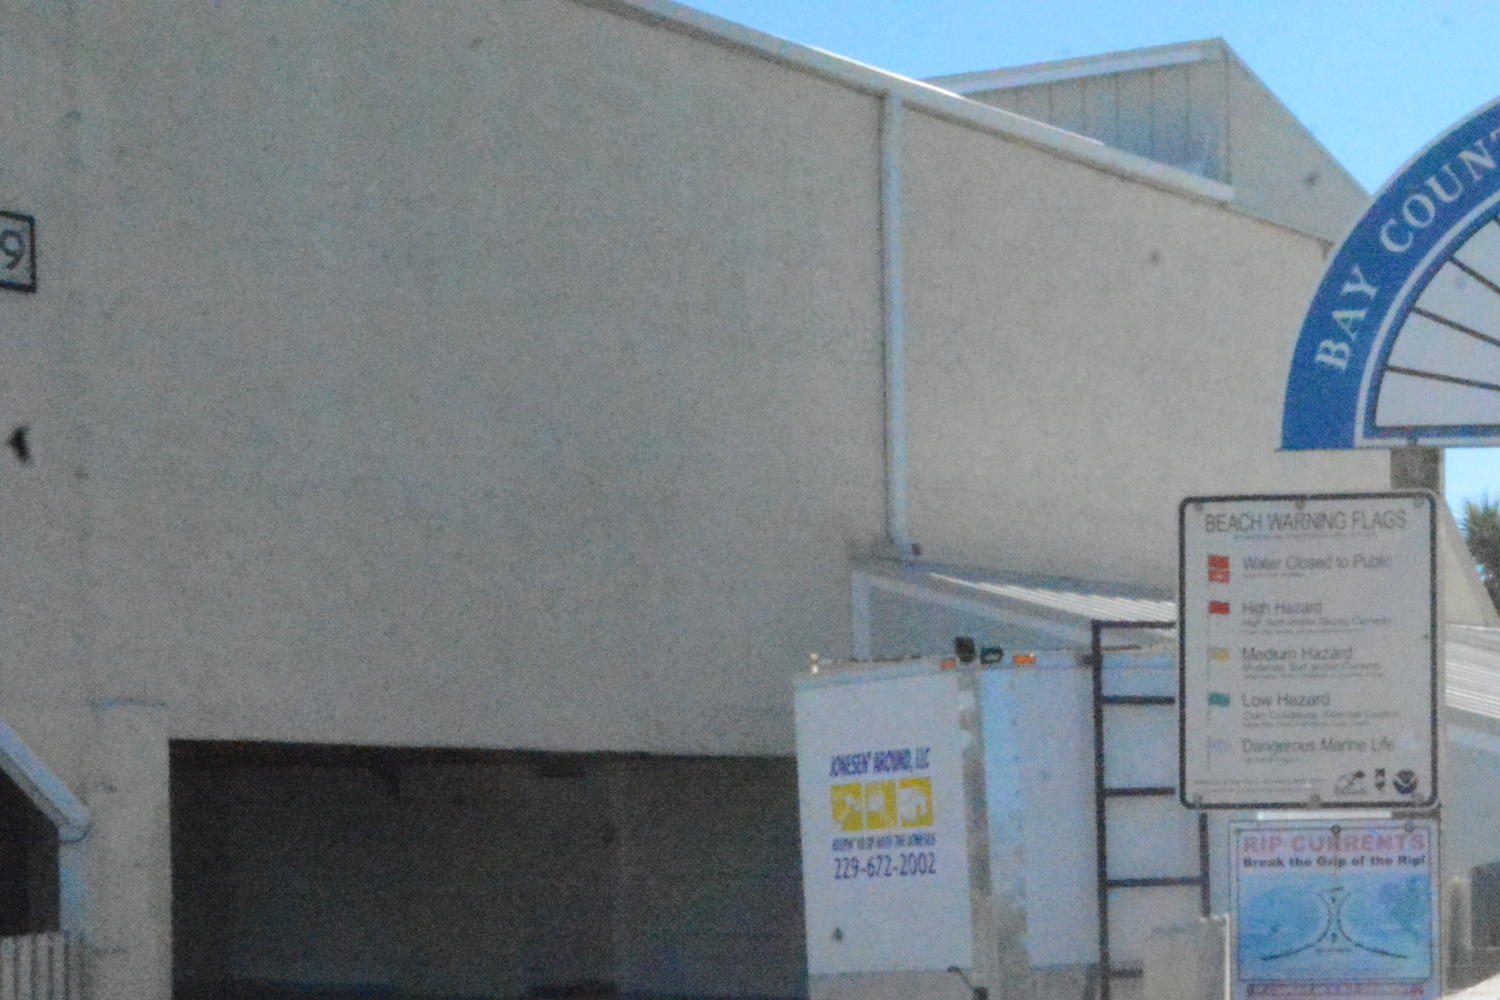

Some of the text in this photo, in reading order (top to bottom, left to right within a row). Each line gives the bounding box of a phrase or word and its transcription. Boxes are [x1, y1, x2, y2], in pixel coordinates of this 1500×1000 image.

[1315, 264, 1377, 371] BAY
[1205, 510, 1408, 532] BEACH WARNING FLAGS
[1243, 557, 1281, 570] Water
[1285, 555, 1332, 570] Closed
[1336, 556, 1349, 569] to
[1242, 601, 1323, 617] High Hazard
[1242, 647, 1352, 661] Medium Hazard
[1242, 692, 1330, 708] Low Hazard
[1242, 735, 1395, 756] Dangerous Marine Life
[1243, 833, 1426, 852] RIP CURRENTS
[834, 851, 937, 880] 229-672-2002
[1243, 856, 1285, 869] Break
[1289, 857, 1312, 868] the
[1316, 856, 1347, 869] Grip
[1351, 855, 1366, 867] of
[1370, 855, 1393, 867] the
